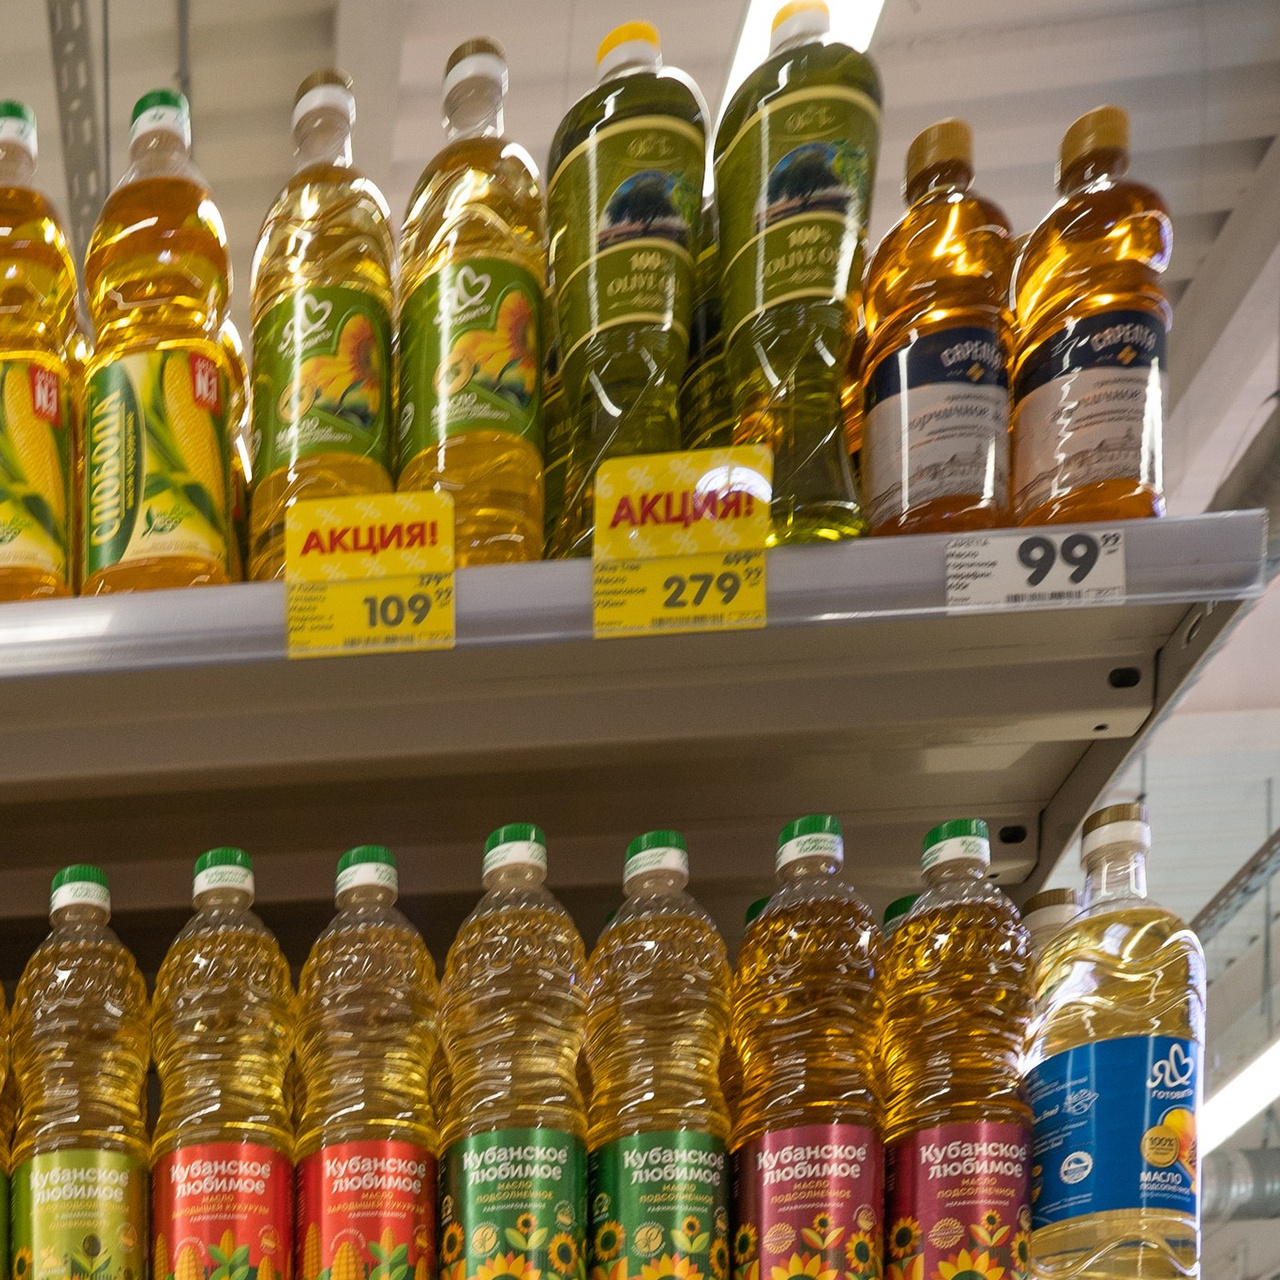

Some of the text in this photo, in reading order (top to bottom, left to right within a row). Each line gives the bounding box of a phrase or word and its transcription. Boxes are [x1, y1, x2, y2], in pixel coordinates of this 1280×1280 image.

[610, 486, 755, 528] АКЦИЯ!
[300, 519, 438, 557] АКЦИЯ!
[1018, 535, 1100, 587] 99
[662, 573, 742, 610] 279
[362, 593, 432, 628] 109
[463, 1145, 568, 1170] Кубанское
[623, 1147, 725, 1169] Кубанское
[756, 1143, 867, 1170] Кубанское
[920, 1141, 1027, 1165] Кубанское
[171, 1159, 271, 1185] Кубанское
[325, 1156, 426, 1179] Кубанское
[468, 1163, 562, 1186] любимое
[631, 1166, 721, 1186] любимое
[763, 1161, 861, 1187] любимое
[928, 1160, 1023, 1182] любимое
[175, 1176, 265, 1200] любимое
[332, 1174, 421, 1195] любимое
